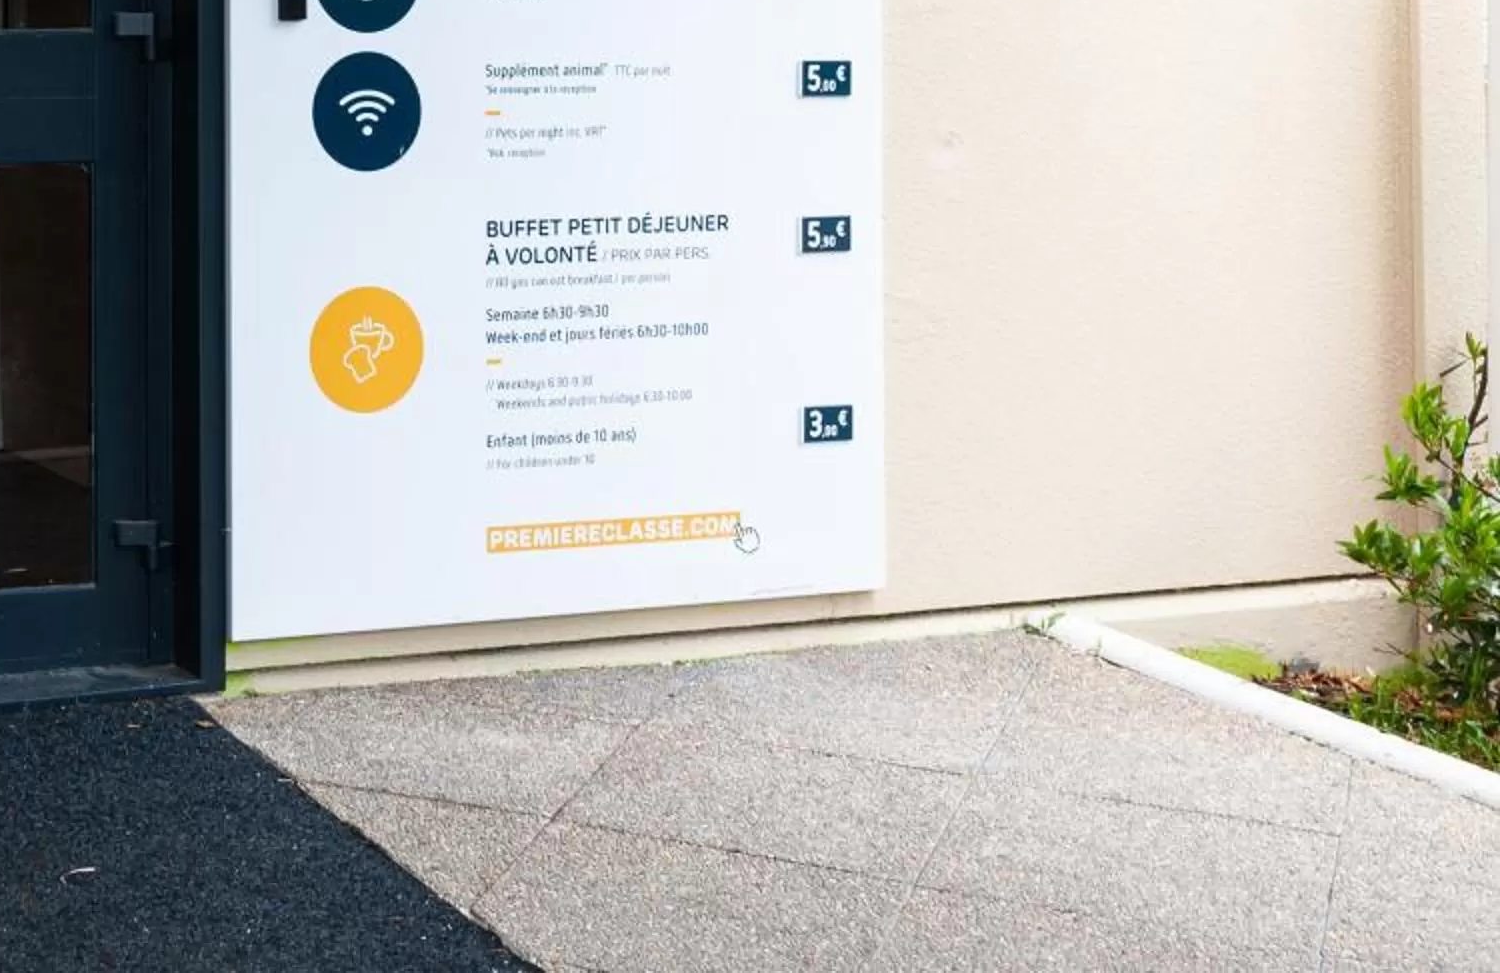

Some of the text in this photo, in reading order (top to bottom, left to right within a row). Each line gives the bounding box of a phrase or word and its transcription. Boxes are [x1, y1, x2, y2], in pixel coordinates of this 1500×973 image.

[485, 62, 559, 80] Supplément
[486, 212, 729, 238] BUFFET PETIT DÉJEUNER
[485, 243, 500, 266] À
[504, 240, 598, 266] VOLONTÉ
[611, 248, 641, 261] PRIX
[644, 247, 671, 261] PAR
[486, 307, 539, 322] Semaine
[486, 329, 547, 345] Week-end
[549, 328, 563, 343] et
[565, 326, 597, 345] jours
[486, 426, 637, 449] Enfant (moins de 10 ans)
[489, 513, 739, 550] PREMIERECLASSE.COM
